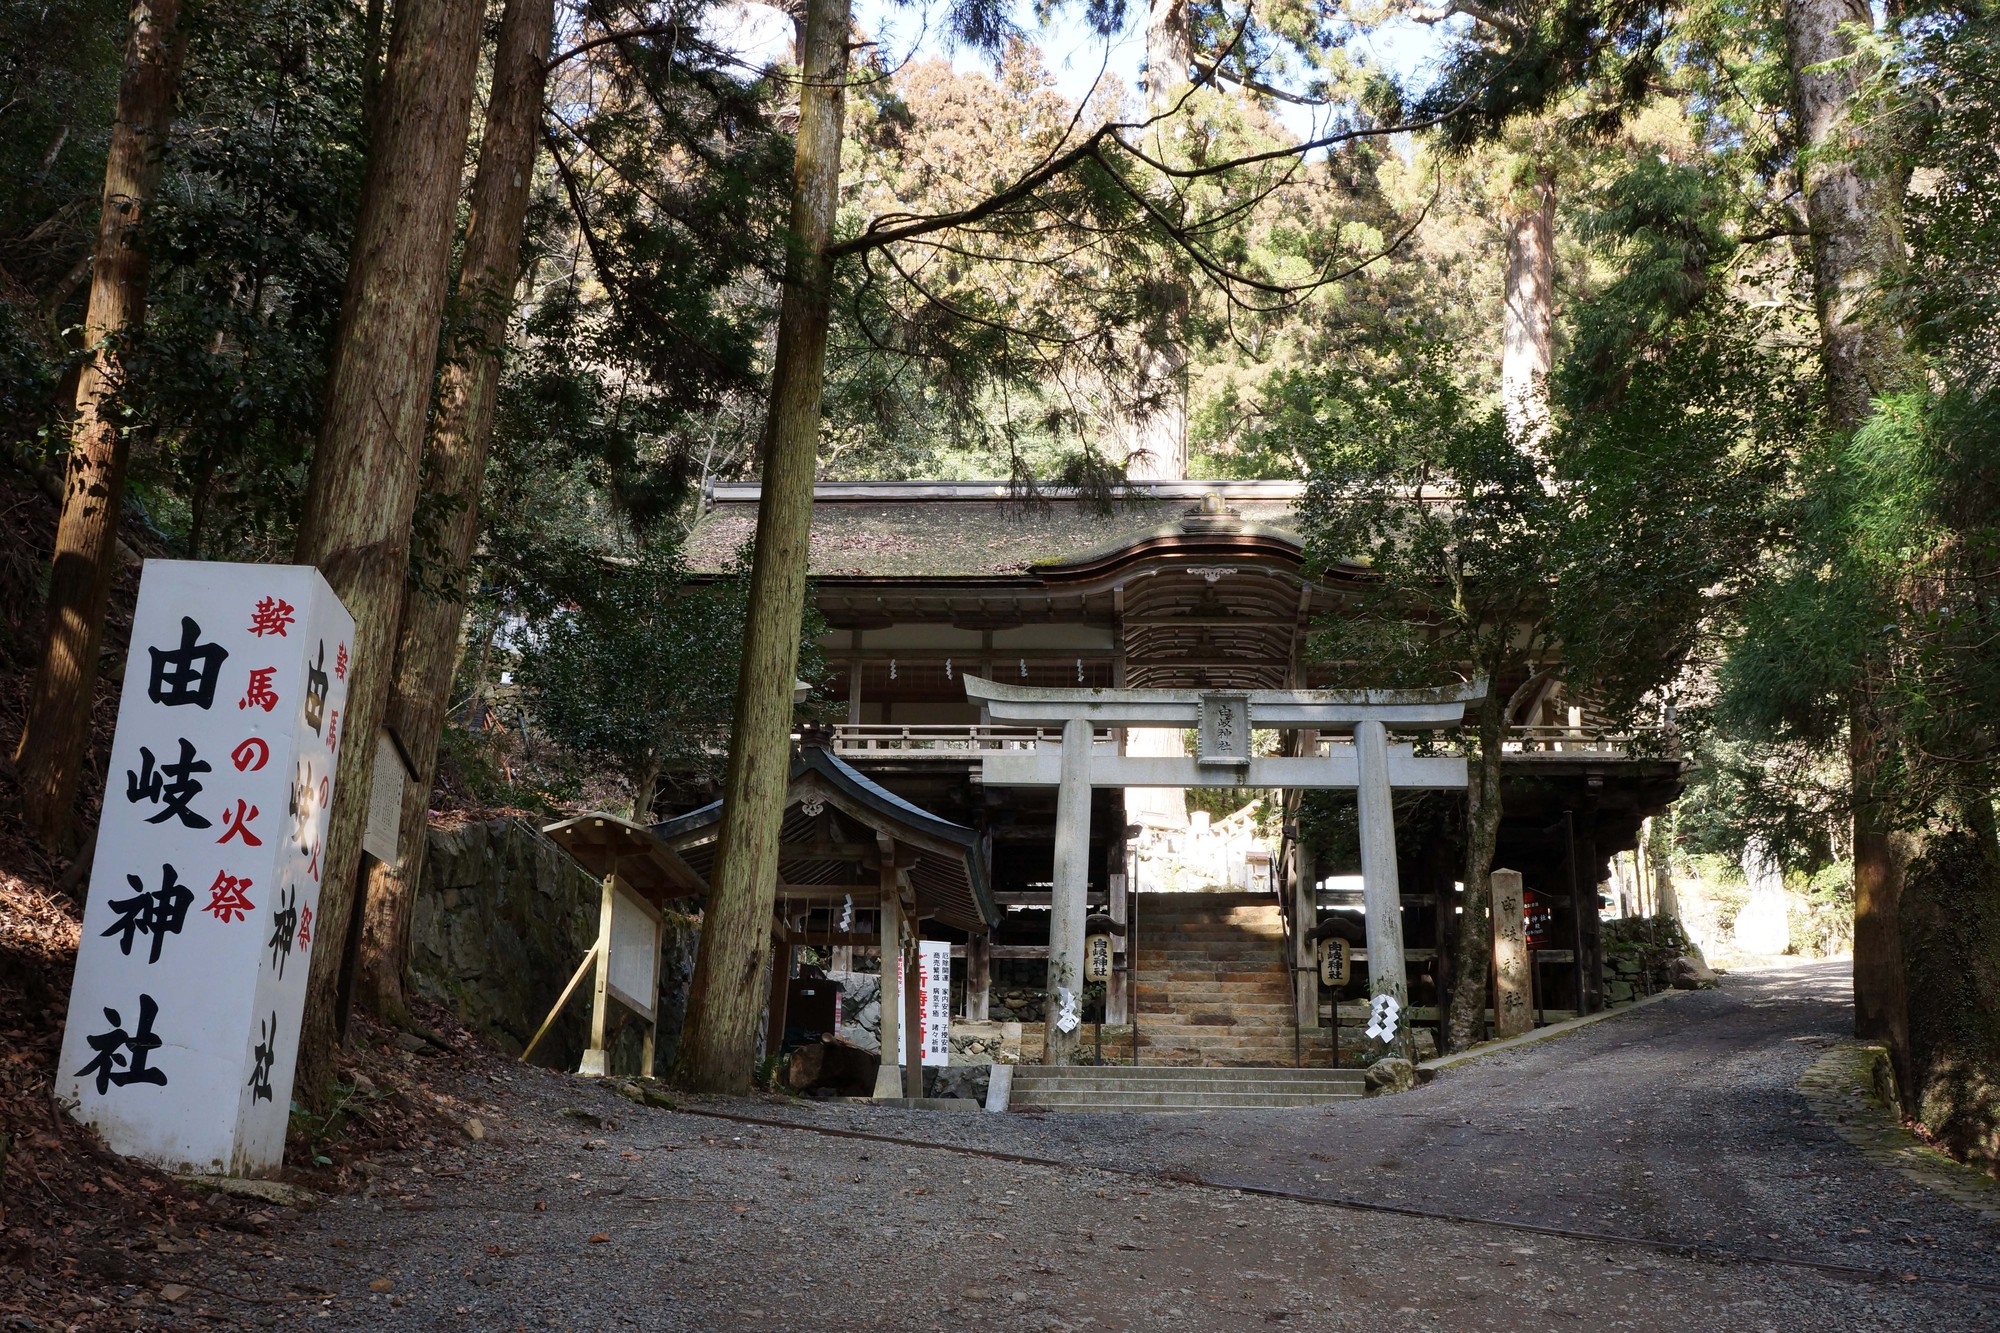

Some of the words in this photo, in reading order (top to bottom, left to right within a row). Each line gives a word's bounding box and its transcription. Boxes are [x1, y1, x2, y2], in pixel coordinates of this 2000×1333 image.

[1218, 705, 1234, 751] 由岐神社
[201, 596, 296, 923] 鞍馬の火祭
[295, 640, 349, 953] 鞍馬の火祭
[74, 616, 229, 1096] 由岐神社
[247, 638, 329, 1107] 由岐神社
[1093, 939, 1107, 976] 由岐神社
[1328, 942, 1343, 979] 由岐神社
[1501, 896, 1524, 1007] 由岐神社
[941, 988, 949, 1018] 家内安全
[931, 1024, 939, 1054] 諸々祈願
[940, 1024, 948, 1054] 子授安産
